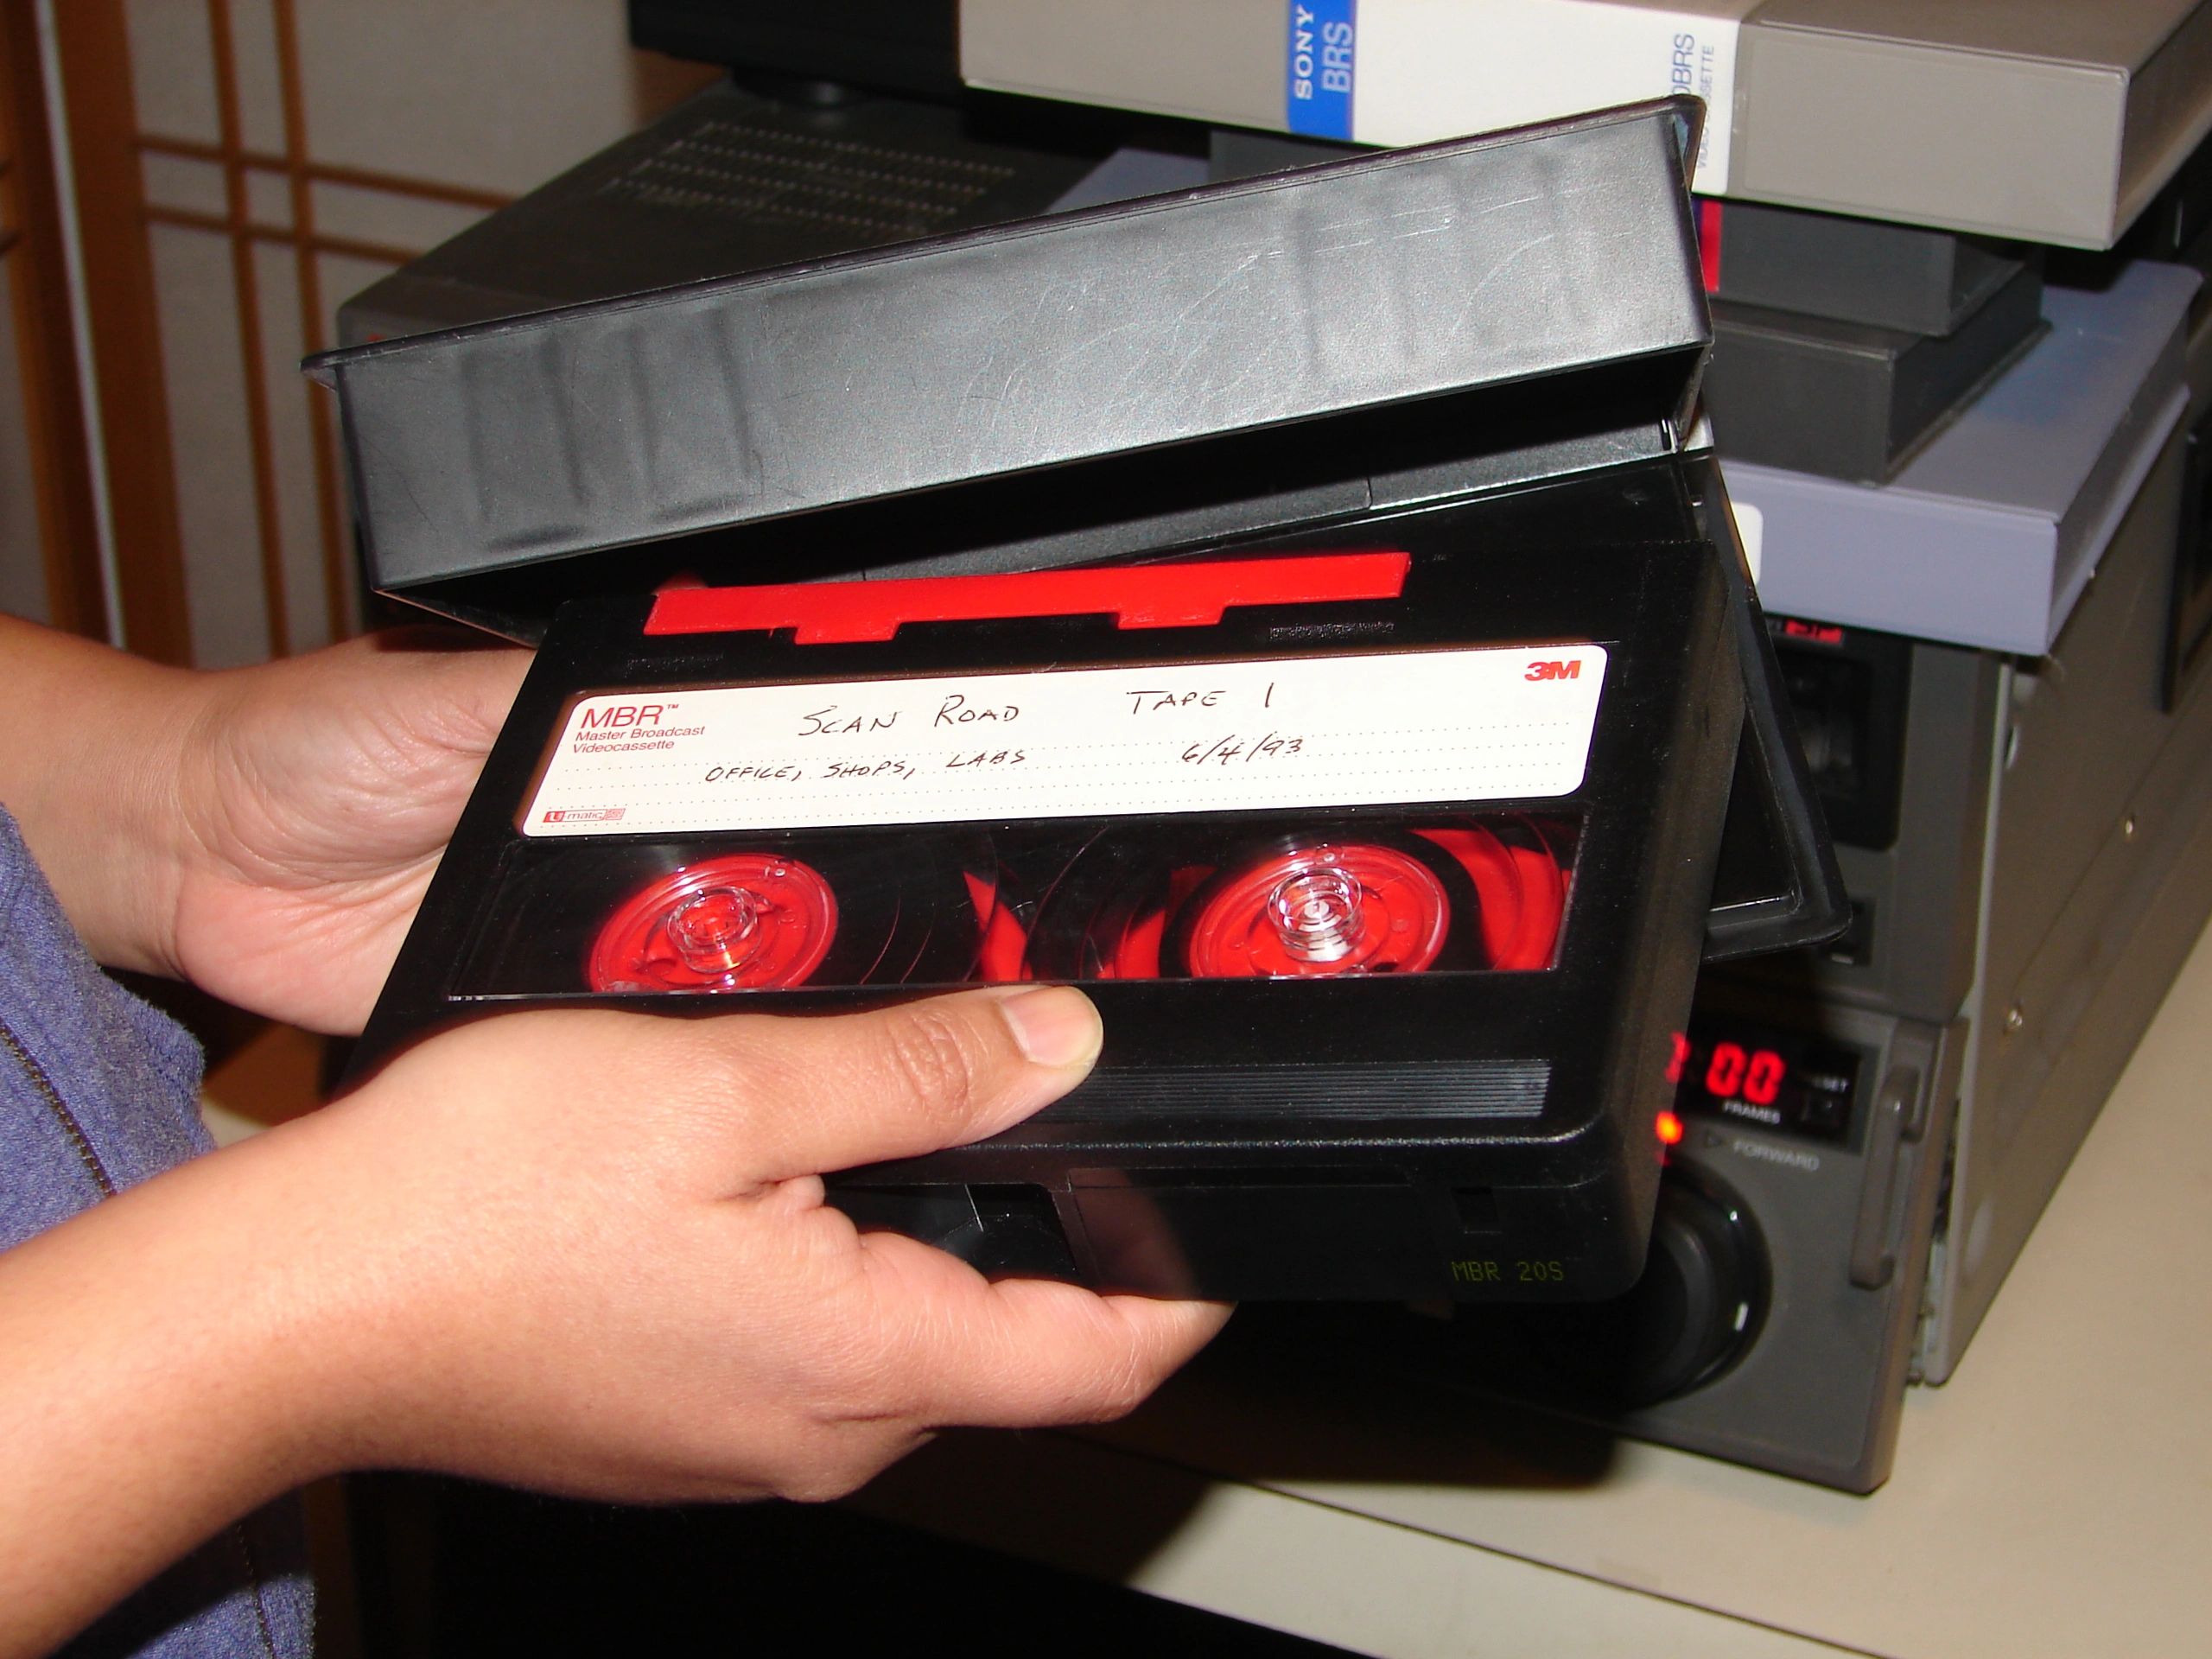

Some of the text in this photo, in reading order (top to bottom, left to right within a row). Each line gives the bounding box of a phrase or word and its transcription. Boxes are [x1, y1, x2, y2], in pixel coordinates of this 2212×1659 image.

[1294, 3, 1314, 101] SONY
[1322, 21, 1353, 93] BRS
[1524, 659, 1582, 682] 3M
[798, 705, 902, 736] SCAN
[934, 693, 1020, 728] ROAD
[1126, 690, 1228, 715] TAPE
[573, 740, 675, 754] Videocassette
[575, 726, 706, 742] Master Broadcast
[705, 731, 1304, 783] OFFICE, SHOPS, LABS 6/4/93
[1724, 1100, 1782, 1124] FRAMES
[1732, 1140, 1820, 1172] FORWARD
[1451, 1261, 1564, 1281] MBR 20S
